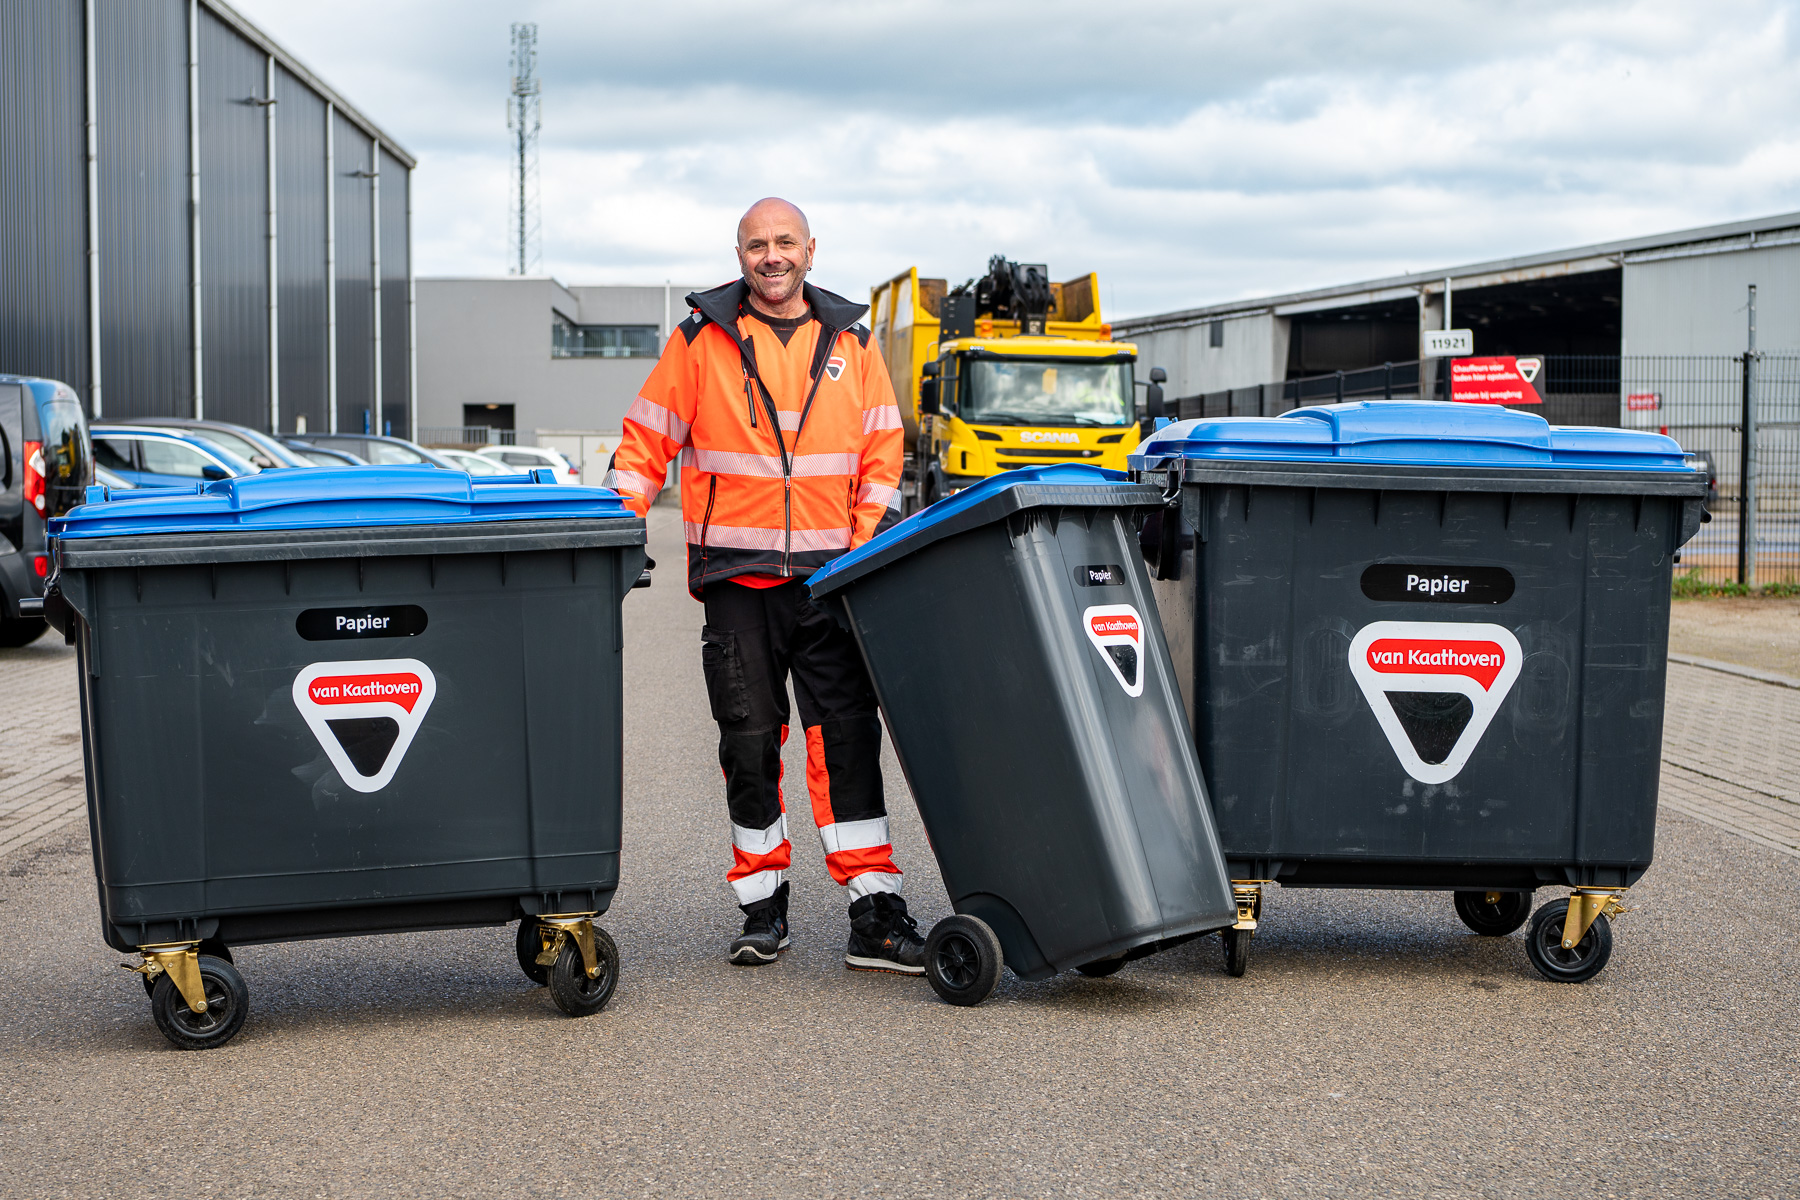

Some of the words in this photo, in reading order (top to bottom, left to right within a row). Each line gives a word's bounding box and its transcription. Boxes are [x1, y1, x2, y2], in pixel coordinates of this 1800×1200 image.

[1432, 338, 1465, 349] 11921
[1020, 431, 1080, 444] SCANIA
[1089, 569, 1112, 582] Papier
[1406, 574, 1470, 596] Papier
[335, 614, 390, 633] Papier
[1093, 623, 1106, 632] van
[1105, 620, 1138, 631] Kaathoven
[1371, 651, 1404, 665] van
[1408, 649, 1501, 667] Kaathoven
[312, 686, 340, 698] van
[342, 681, 420, 697] Kaathoven
